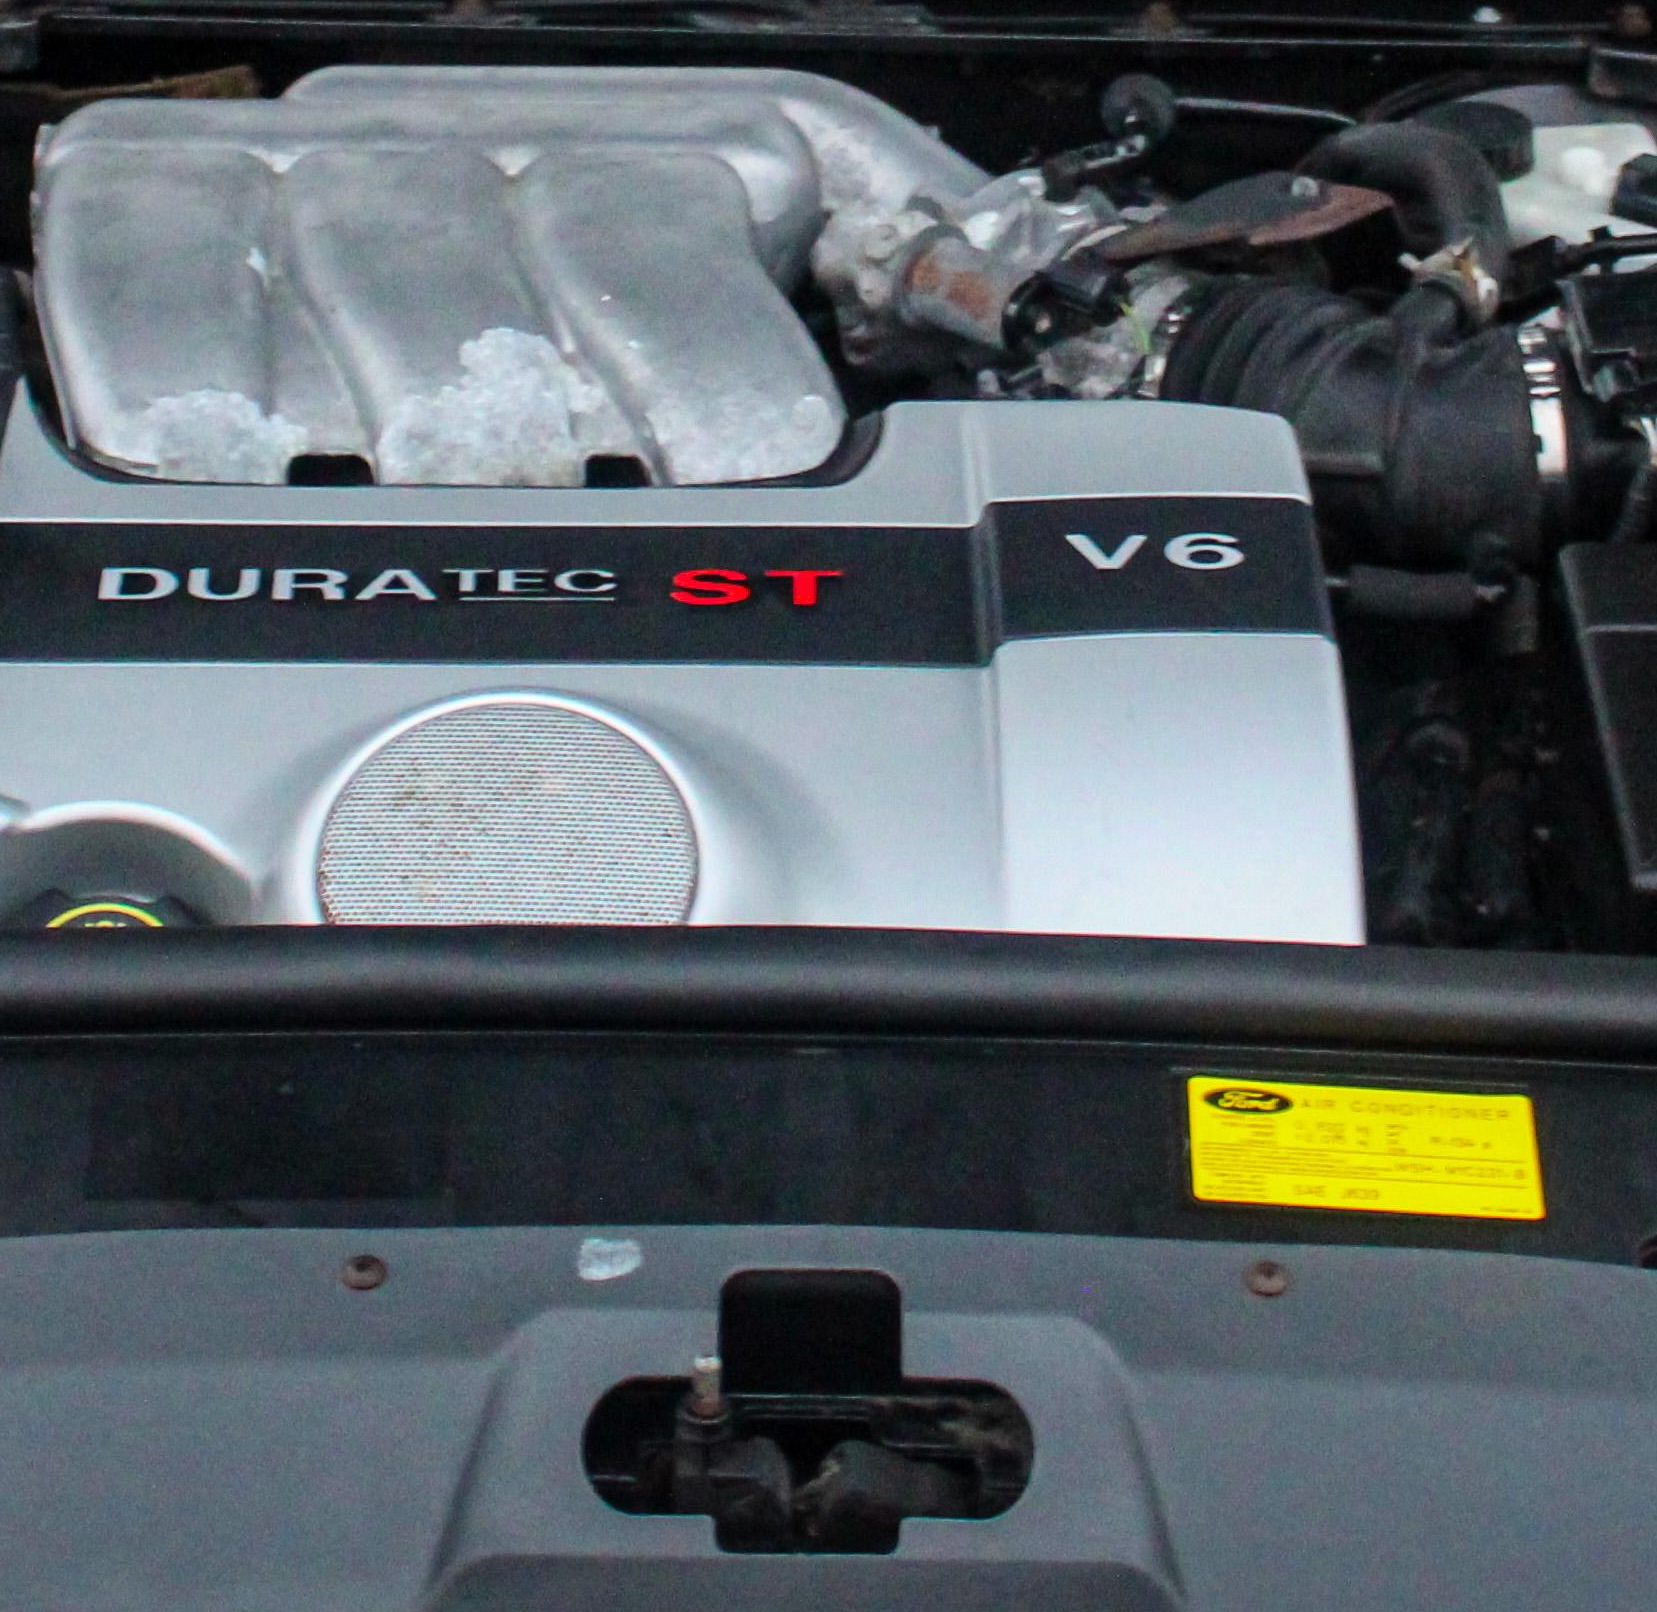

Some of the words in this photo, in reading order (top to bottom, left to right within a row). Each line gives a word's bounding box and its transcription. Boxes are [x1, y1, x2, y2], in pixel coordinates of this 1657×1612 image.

[1064, 532, 1245, 570] V6
[98, 566, 618, 601] DURATEC
[669, 568, 842, 605] ST
[1218, 1090, 1279, 1111] Ford
[1299, 1097, 1337, 1110] AIR
[1349, 1099, 1511, 1120] CONDITIONER
